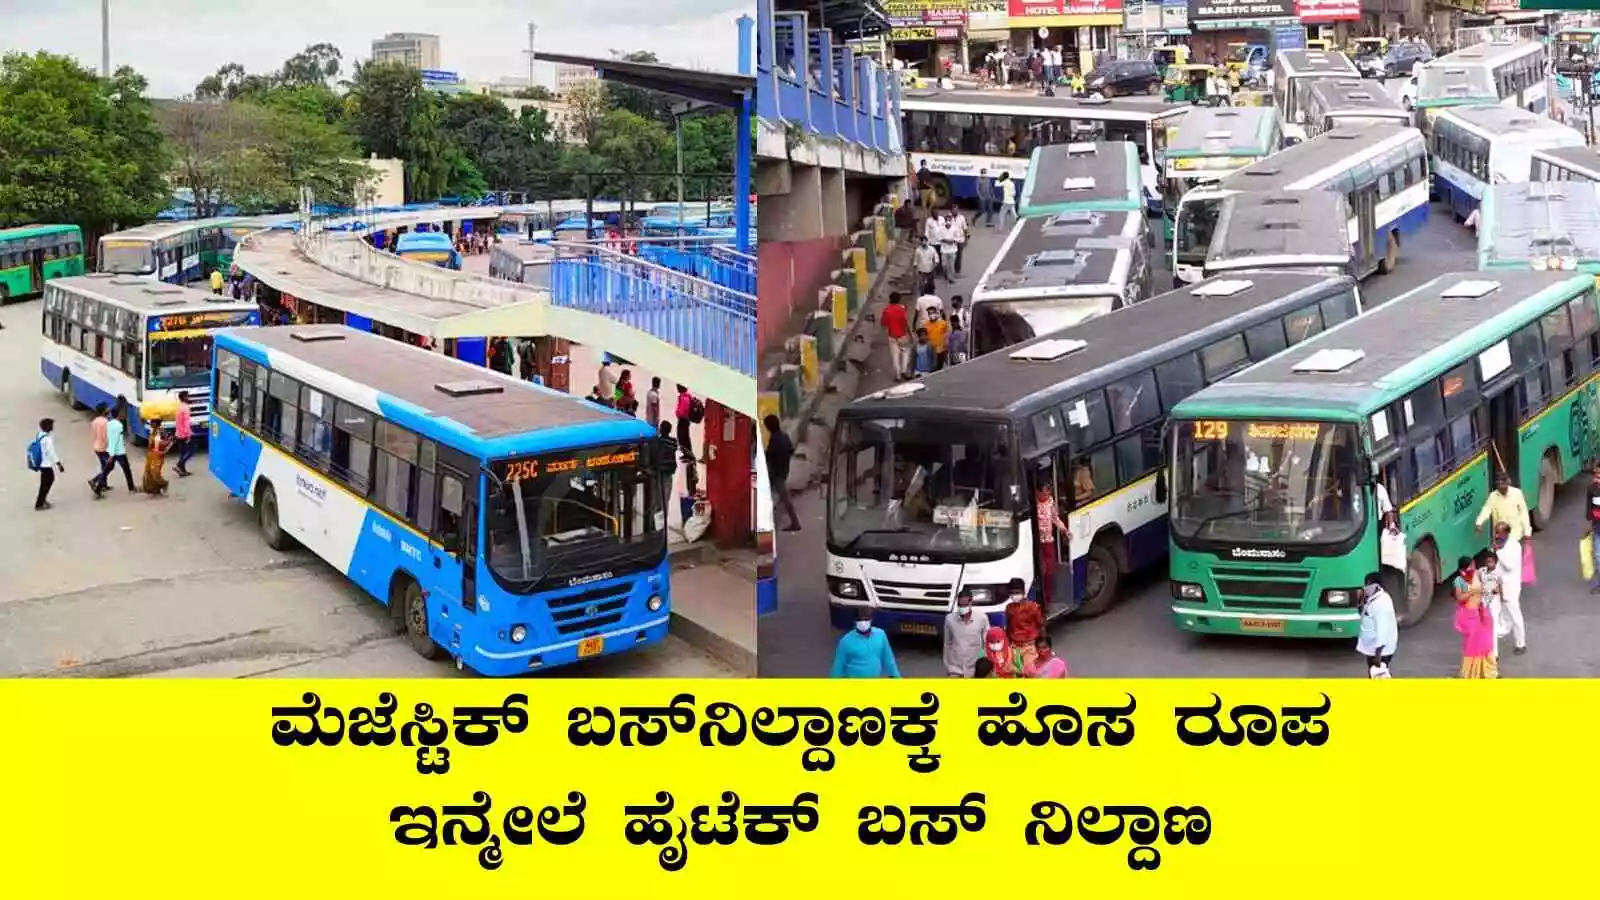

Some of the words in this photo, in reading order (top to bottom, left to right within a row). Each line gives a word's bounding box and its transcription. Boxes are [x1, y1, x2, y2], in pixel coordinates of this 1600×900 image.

[1024, 6, 1059, 16] HOTEL
[1198, 5, 1249, 15] MAJESTIC
[1251, 4, 1285, 13] HOTEL
[1194, 420, 1228, 439] 129
[506, 460, 539, 482] 225C
